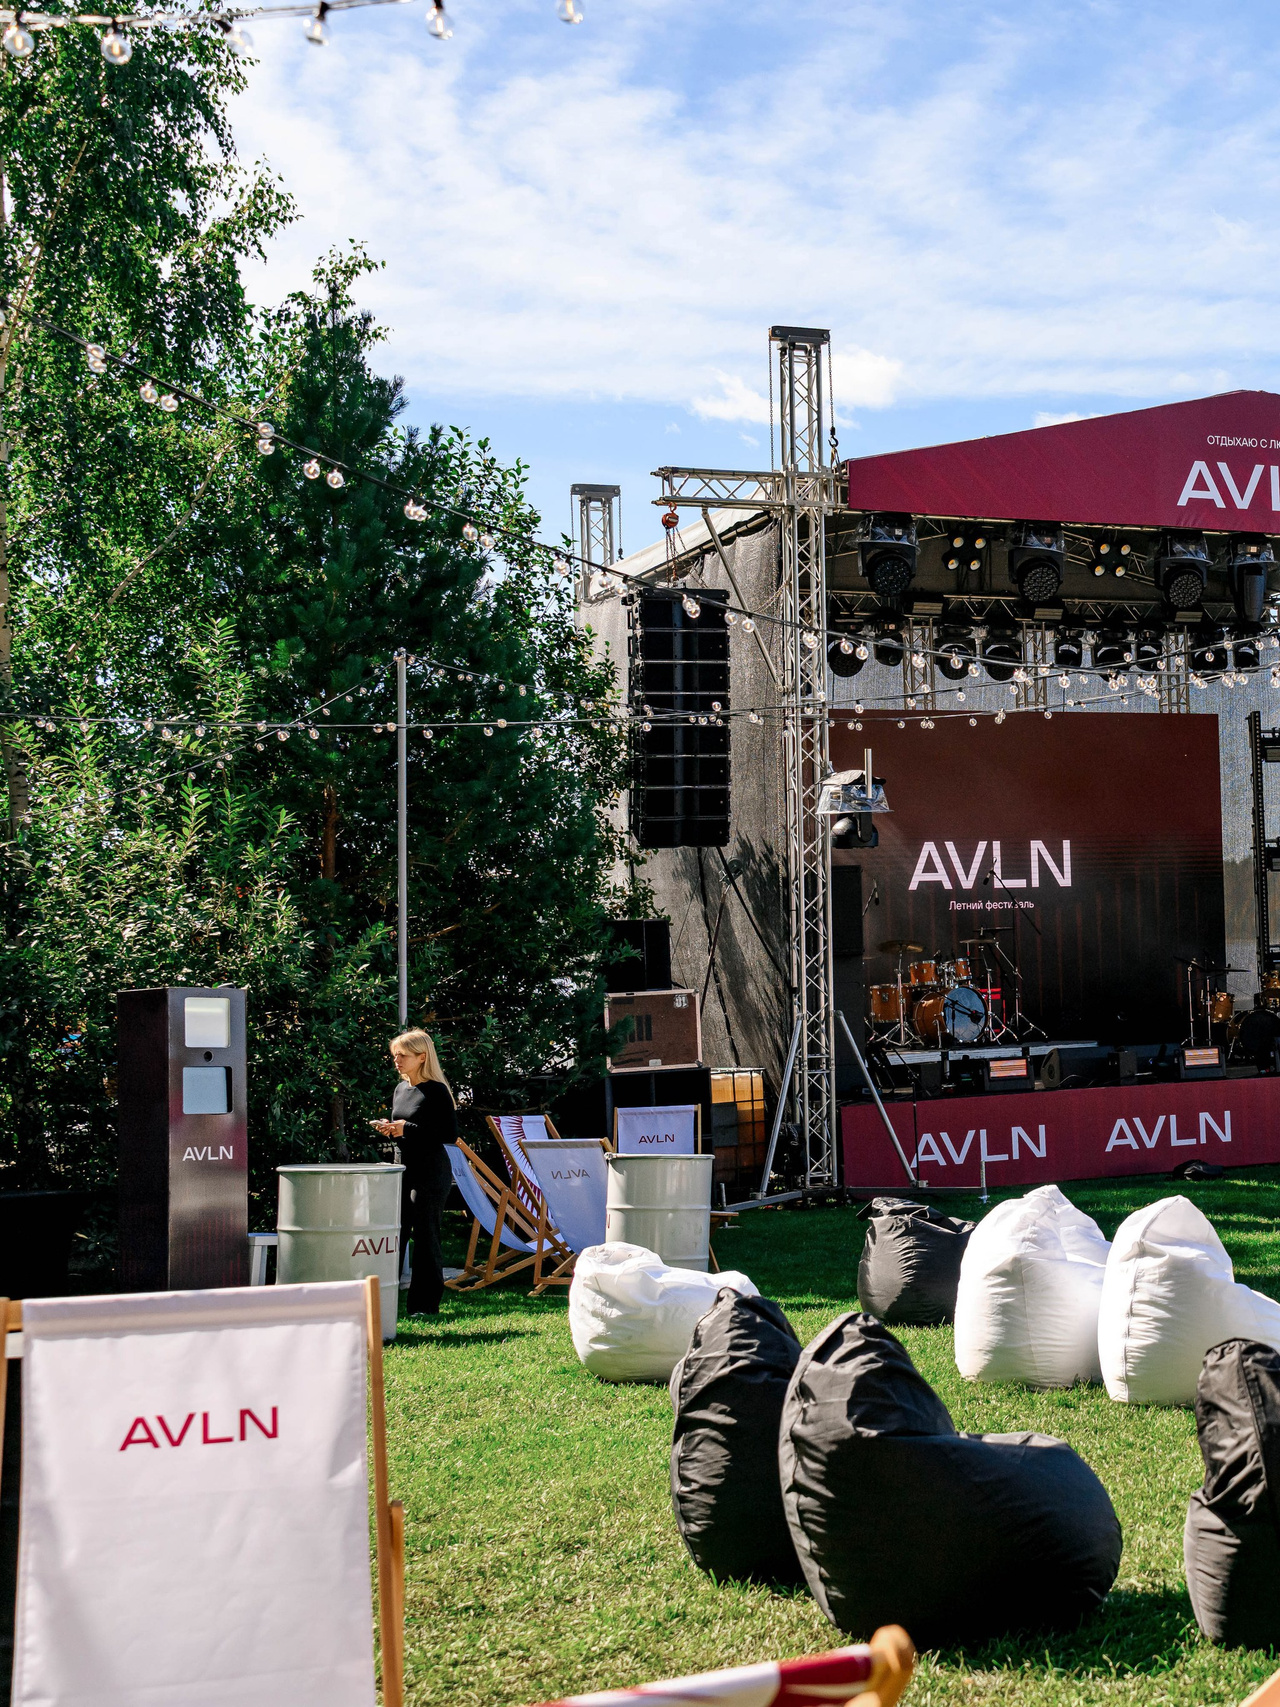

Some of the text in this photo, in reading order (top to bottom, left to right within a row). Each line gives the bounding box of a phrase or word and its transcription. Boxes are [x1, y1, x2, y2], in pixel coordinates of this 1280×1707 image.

[1207, 435, 1258, 448] ОТДЫХАЮ
[1260, 438, 1268, 449] С
[908, 840, 1072, 890] AVLN
[949, 900, 983, 911] Летний
[639, 1134, 675, 1144] AVLN
[1105, 1110, 1232, 1152] AVLN
[182, 1145, 233, 1161] AVLN
[910, 1125, 1047, 1168] AVLN
[118, 1406, 279, 1451] AVLN
